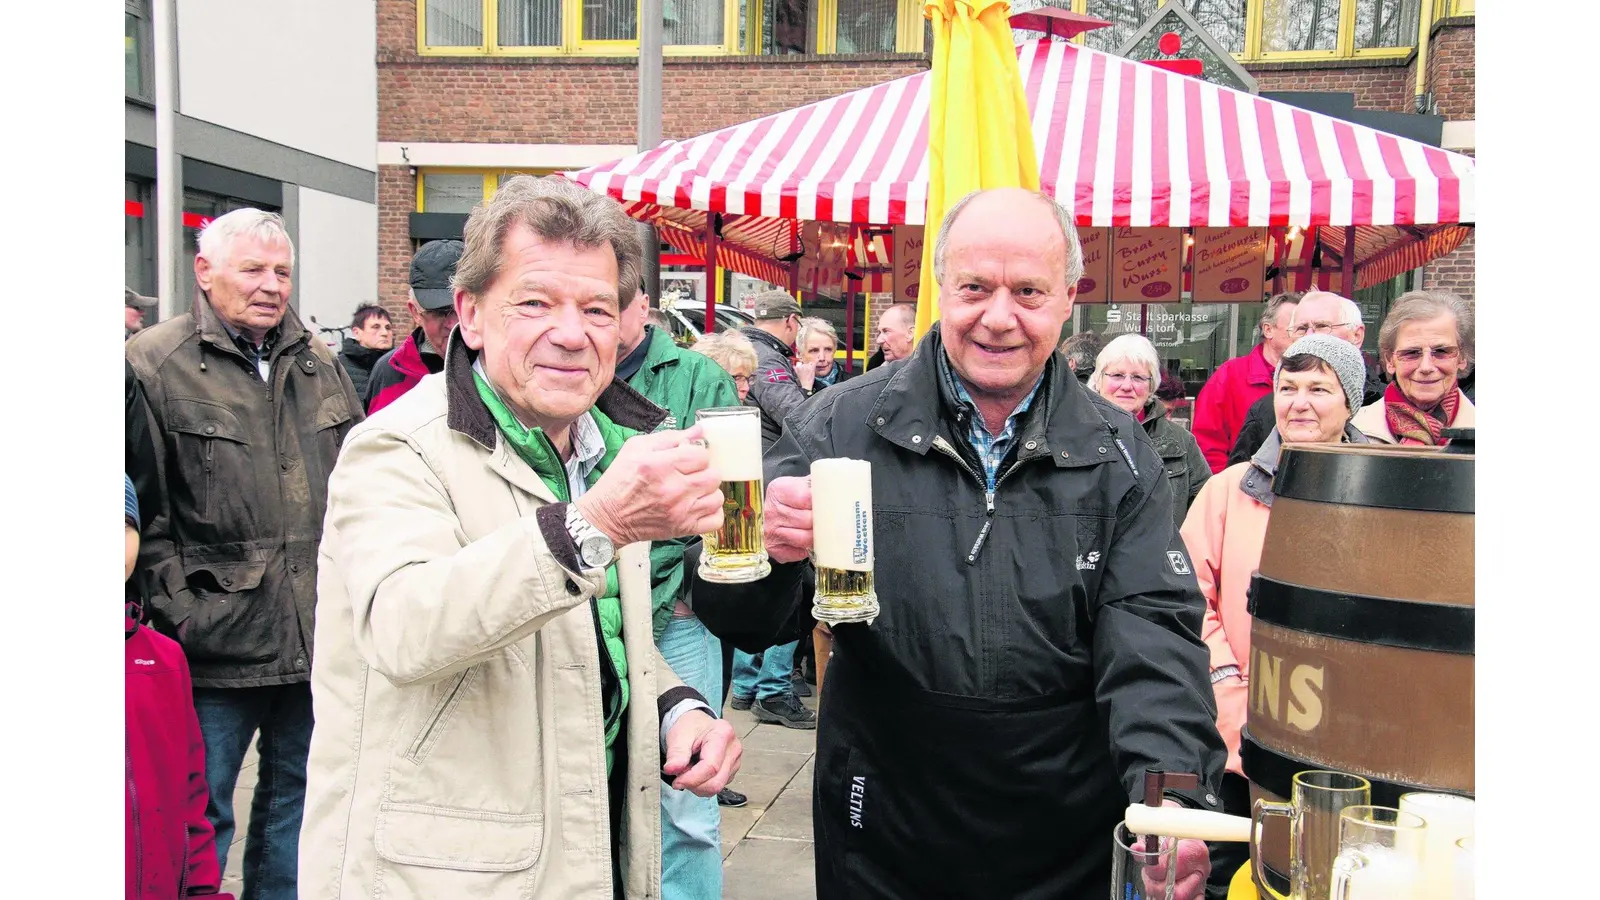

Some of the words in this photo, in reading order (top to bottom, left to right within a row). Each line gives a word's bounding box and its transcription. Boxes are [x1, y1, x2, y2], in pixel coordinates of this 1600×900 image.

[1196, 231, 1259, 262] Bratwurst
[1204, 229, 1232, 244] Unsere
[1082, 249, 1102, 266] rill
[849, 775, 866, 829] VELTINS
